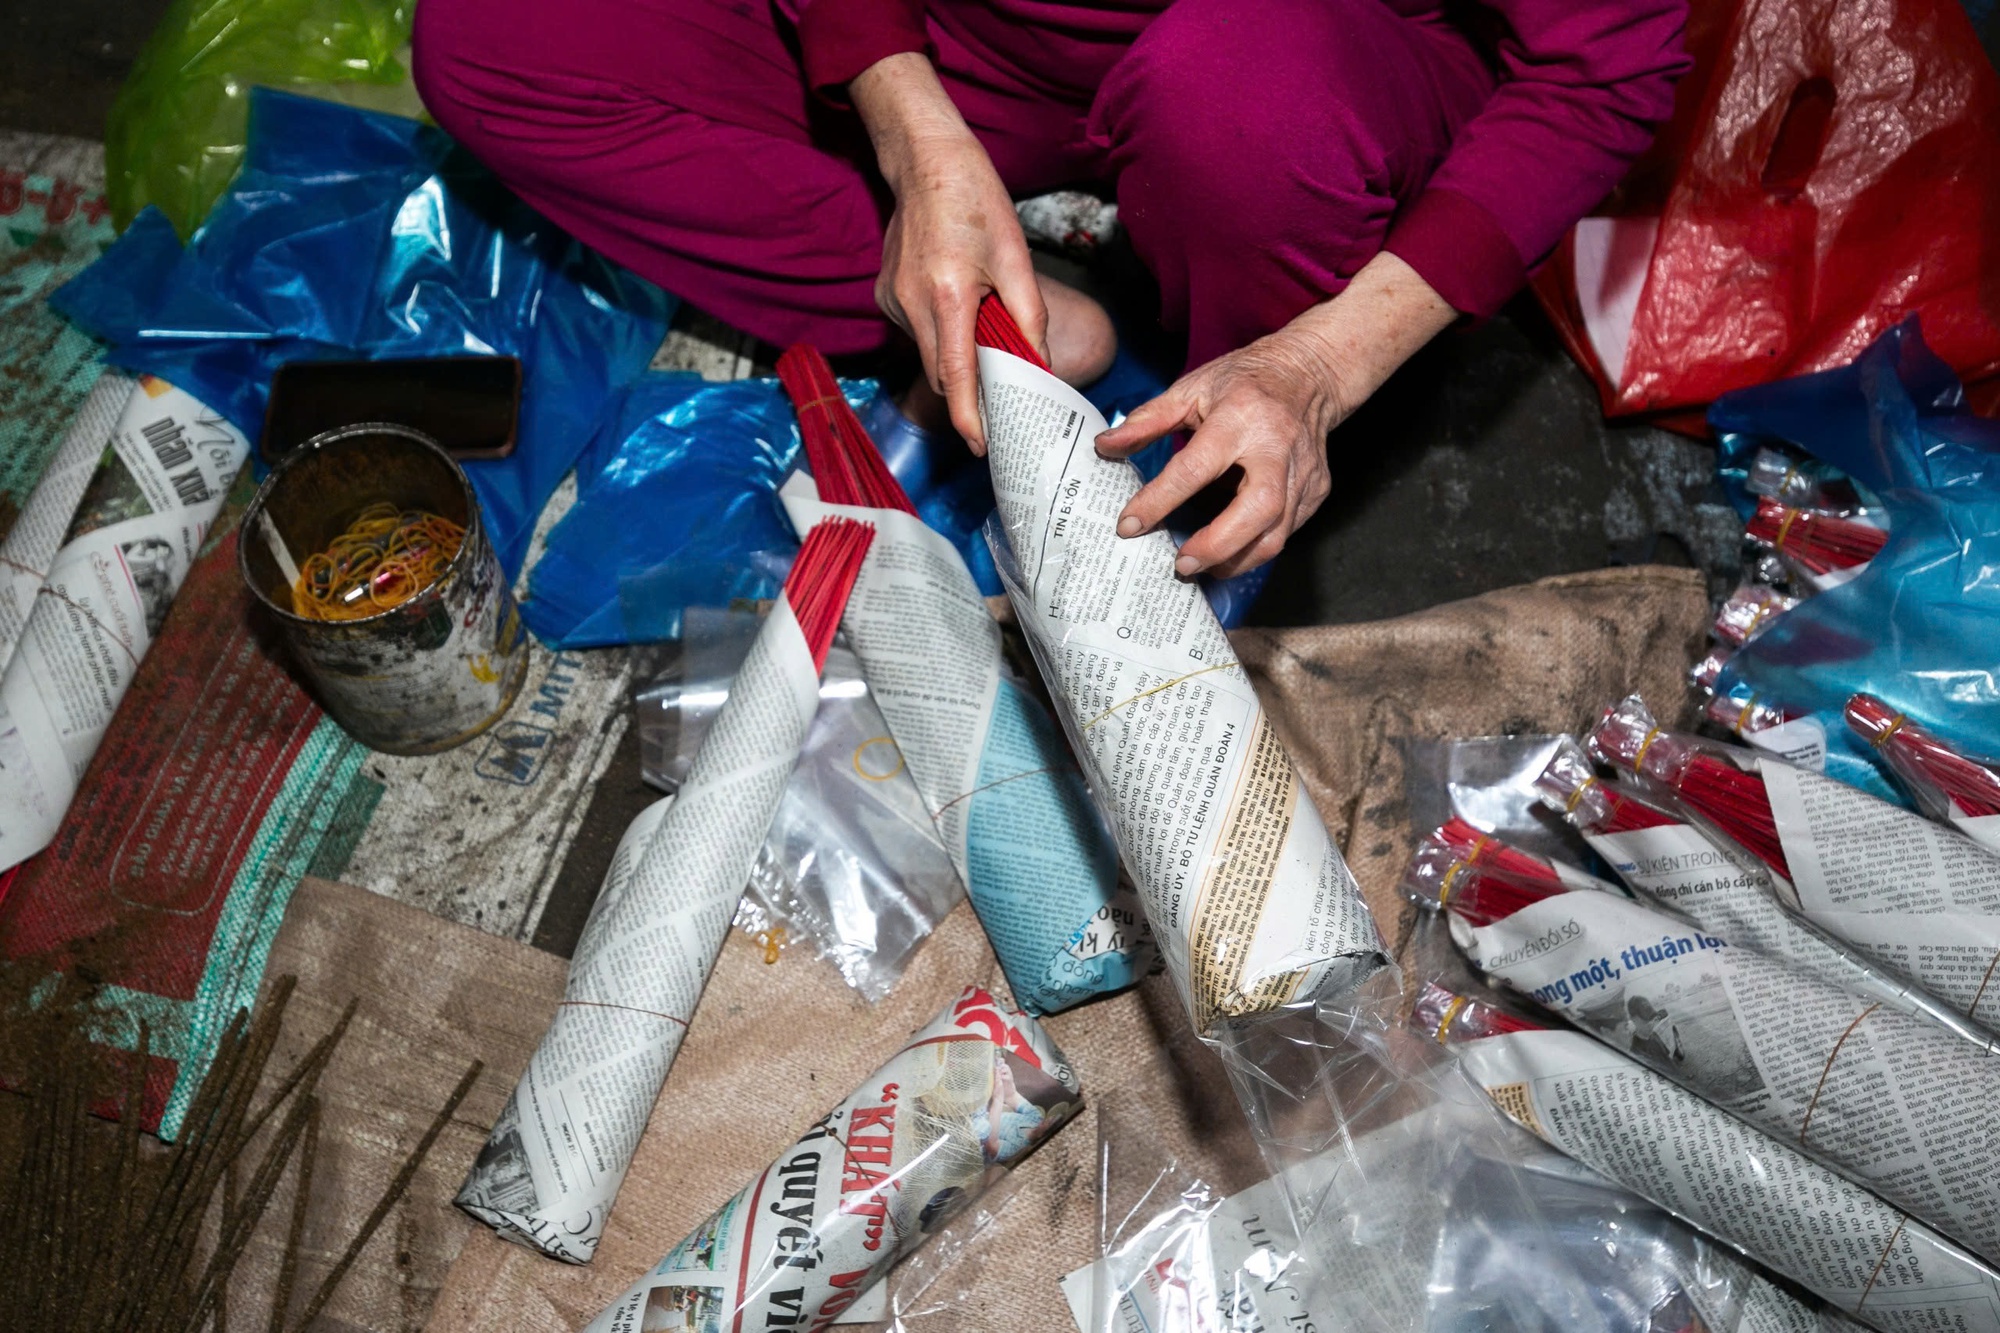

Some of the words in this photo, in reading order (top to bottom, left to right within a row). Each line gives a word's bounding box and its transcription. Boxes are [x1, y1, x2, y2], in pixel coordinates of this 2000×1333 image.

[1183, 598, 1194, 618] QUANG
[1084, 654, 1098, 679] sáng
[1096, 657, 1109, 682] đoàn
[1106, 676, 1118, 691] tác
[1156, 743, 1168, 759] các
[1163, 729, 1172, 742] cơ
[1176, 680, 1188, 700] đơn
[1118, 721, 1131, 749] Quân
[1143, 743, 1153, 755] ơn
[1148, 723, 1161, 740] cấp
[1167, 783, 1184, 809] Quân
[1179, 757, 1193, 780] đoàn
[1191, 719, 1206, 744] hoàn
[1200, 690, 1215, 715] thành
[1161, 766, 1175, 790] quan
[1192, 767, 1205, 789] năm
[1179, 850, 1192, 867] BỘ
[1186, 830, 1198, 845] TƯ
[1192, 800, 1210, 830] LỆNH
[1204, 766, 1222, 798] QUÂN
[1215, 731, 1233, 763] ĐOÀN
[1185, 790, 1197, 803] 50
[1179, 804, 1192, 826] suốt
[1168, 828, 1185, 854] trong
[1694, 881, 1713, 894] cán
[1715, 877, 1731, 892] bộ
[1733, 871, 1753, 889] cấp
[1569, 958, 1620, 992] một,
[1621, 936, 1694, 970] thuận
[1813, 1187, 1824, 1205] các
[1819, 1210, 1834, 1236] đồng
[1841, 1187, 1855, 1213] đồng
[1850, 1218, 1864, 1233] chí
[1807, 1216, 1820, 1235] Anh
